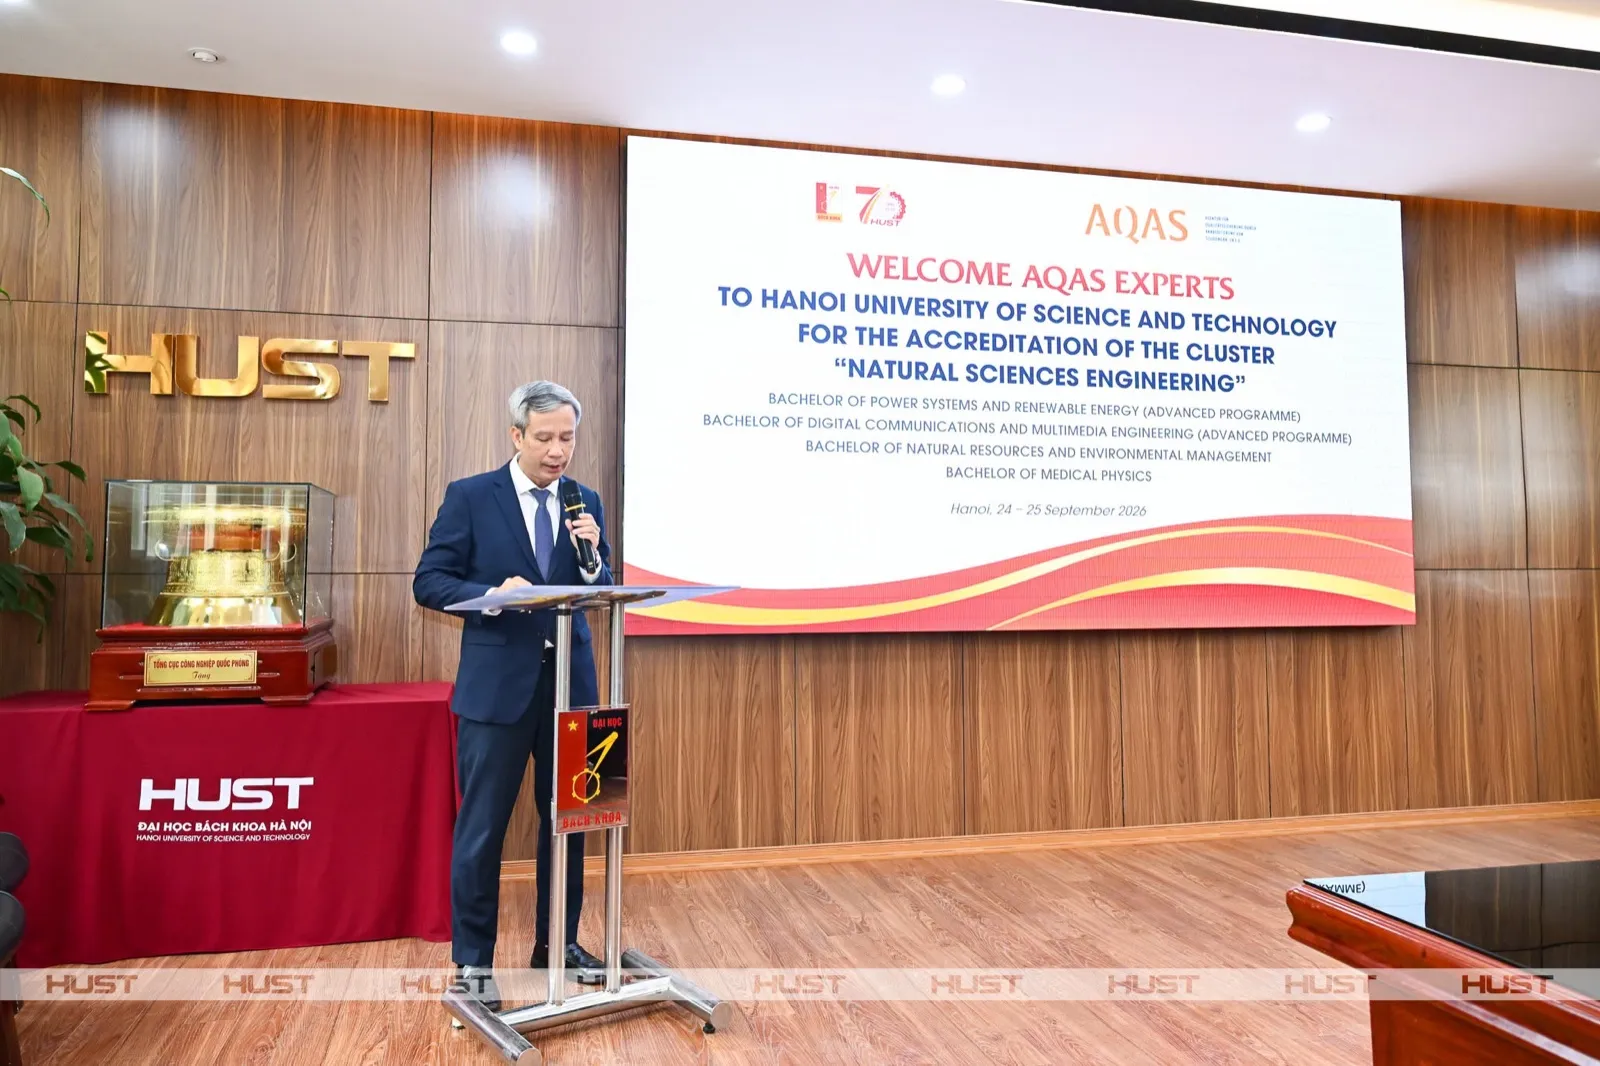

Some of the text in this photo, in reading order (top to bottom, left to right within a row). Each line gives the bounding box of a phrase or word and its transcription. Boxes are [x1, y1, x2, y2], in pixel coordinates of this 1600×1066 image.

[1085, 204, 1188, 243] AQAS
[847, 253, 1234, 300] WELCOME AQAS EXPERTS
[718, 286, 1336, 338] TO HANOI UNIVERSITY OF SCIENCE AND TECHNOLOGY
[799, 323, 1274, 364] FOR THE ACCREDITATION OF THE CLUSTER
[84, 330, 415, 402] HUST
[835, 358, 1245, 392] “NATURAL SCIENCES ENGINEERING”
[768, 392, 1301, 424] BACHELOR OF POWER SYSTEMS AND RENEWABLE ENERGY (ADVANCED PROGRAMME)
[703, 413, 1352, 446] BACHELOR OF DIGITAL COMMUNICATIONS AND MULTIMEDIA ENGINEERING (ADVANCED PROGRAMME)
[806, 439, 1272, 463] BACHELOR OF NATURAL RESOURCES AND ENVIRONMENTAL MANAGEMENT
[946, 466, 1152, 483] BACHELOR OF MEDICAL PHYSICS
[951, 503, 992, 515] Hanoi,
[996, 504, 1012, 515] 24
[1027, 504, 1042, 516] 25
[1044, 504, 1115, 518] September
[1118, 505, 1147, 517] 2026
[138, 777, 314, 811] HUST
[138, 818, 312, 834] ĐẠI HỌC BÁCH KHOA HÀ NỘI
[594, 811, 621, 824] KHOA
[262, 833, 311, 841] TECHNOLOGY
